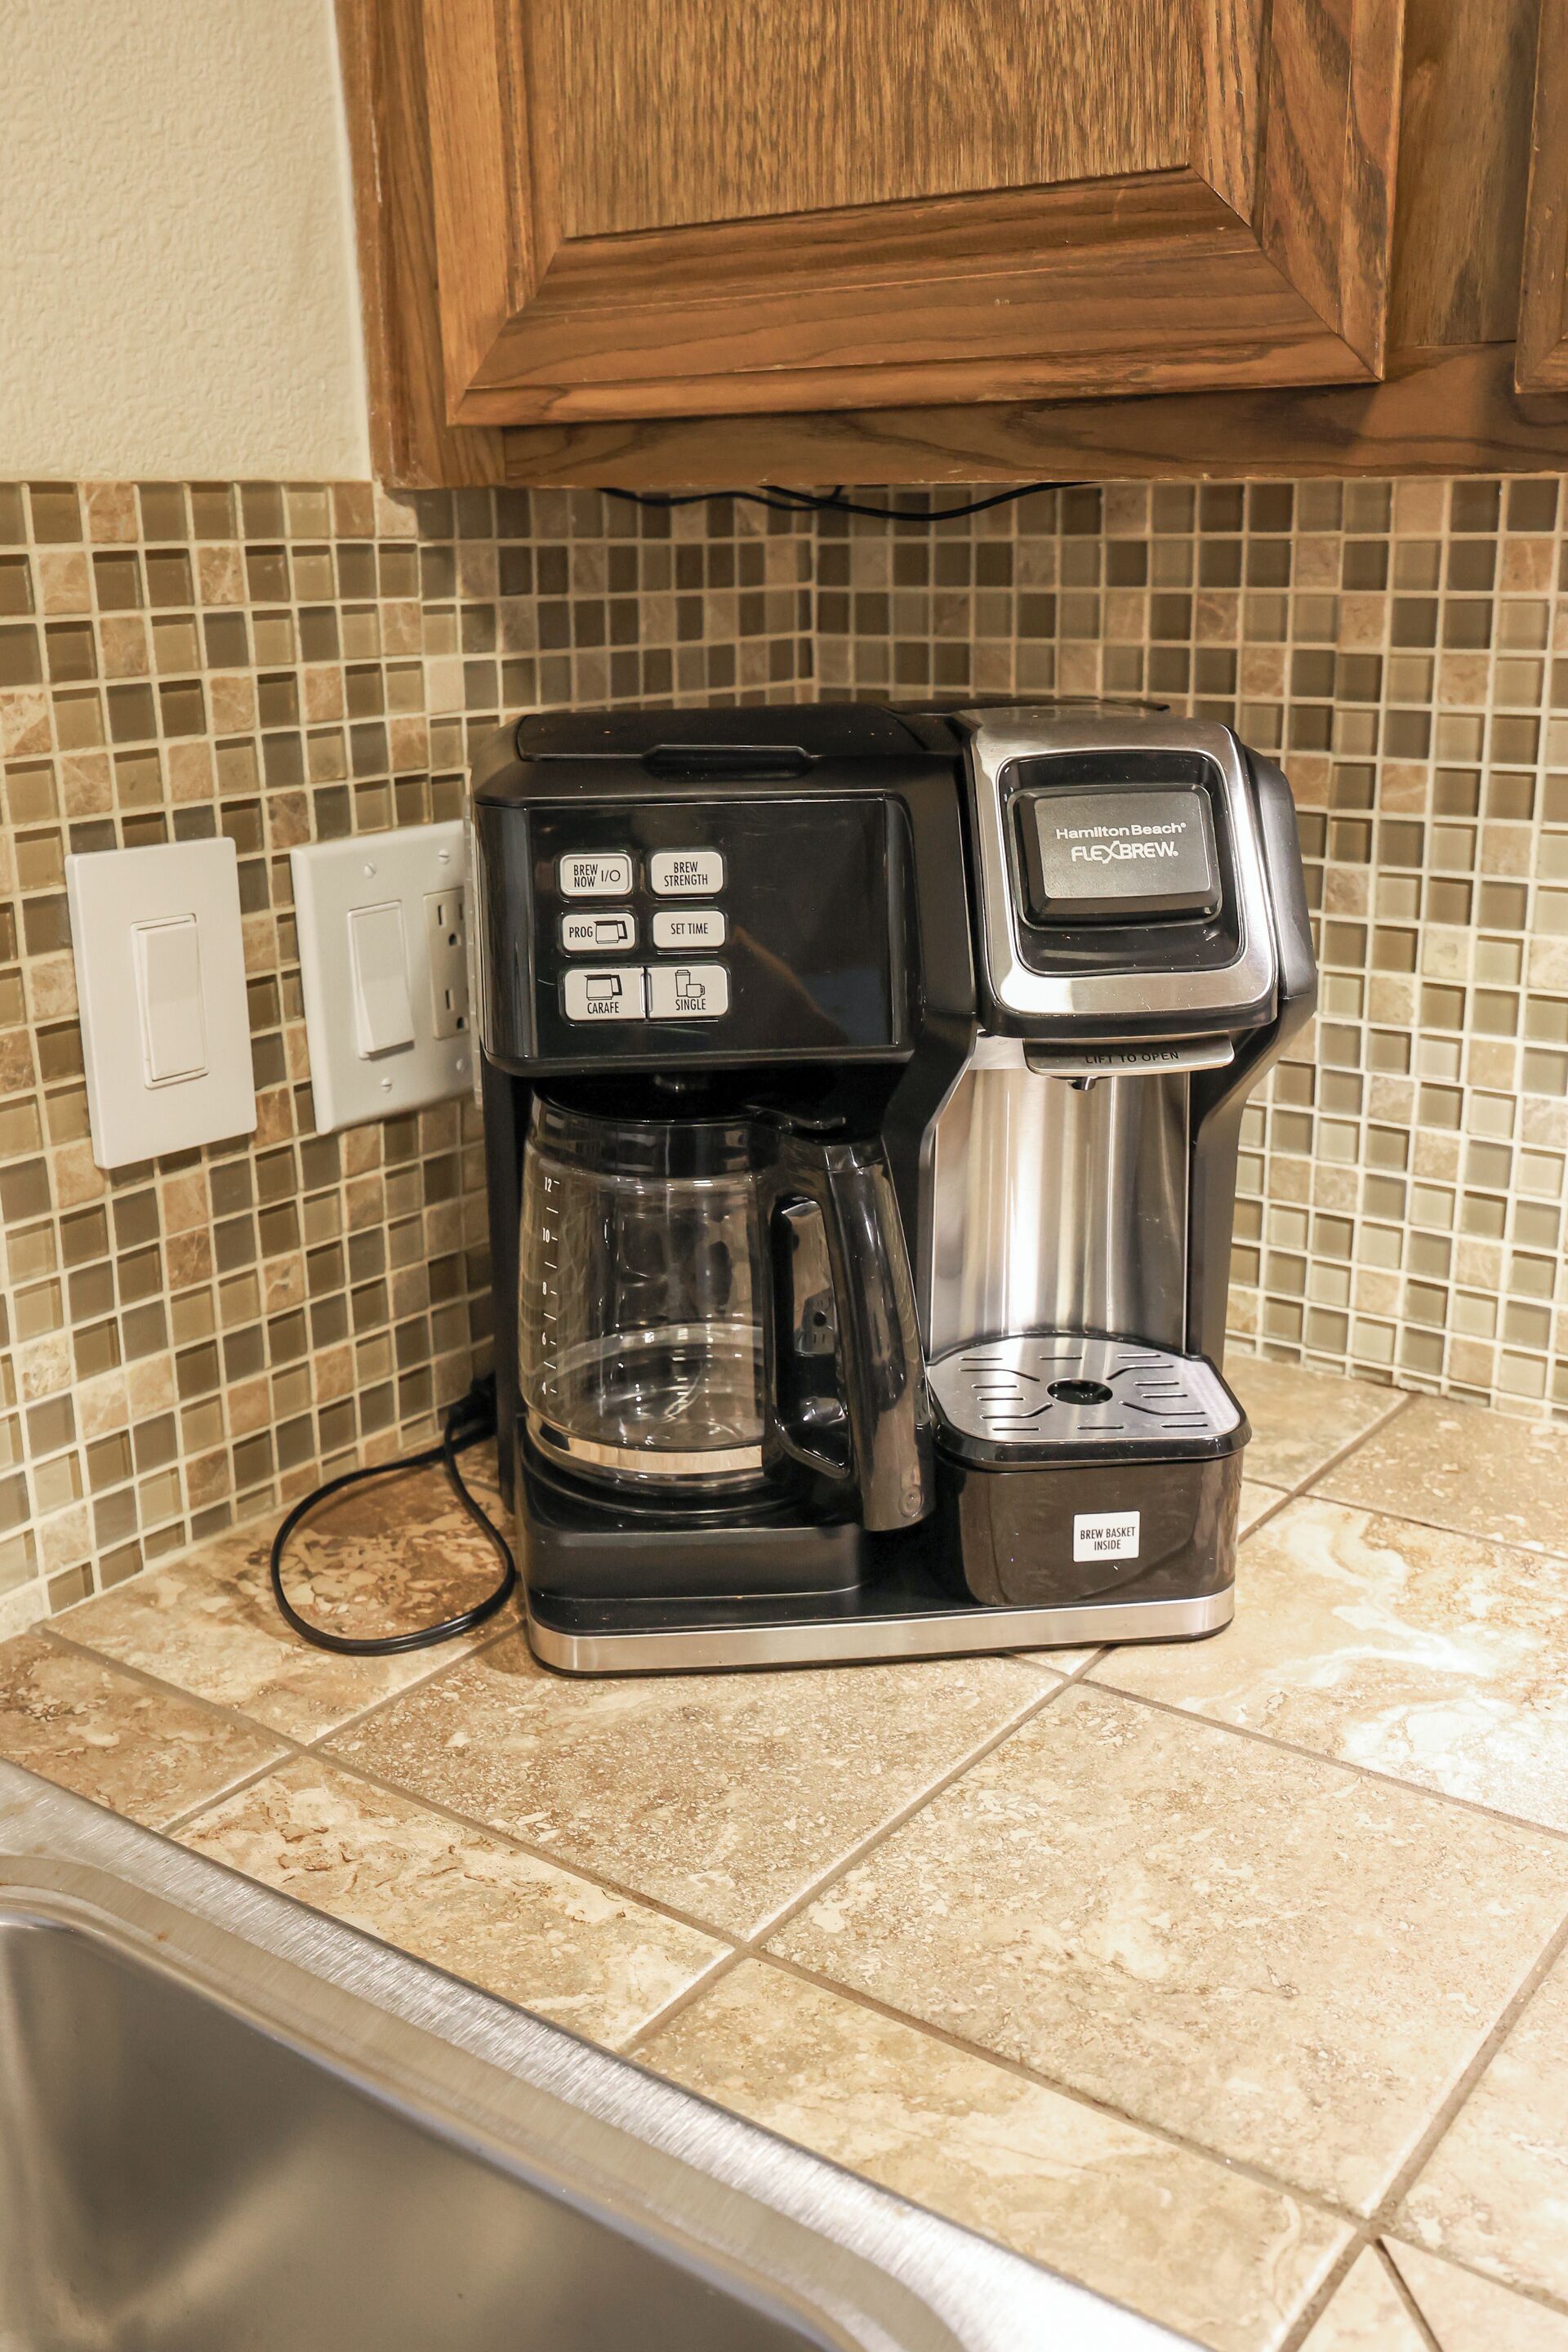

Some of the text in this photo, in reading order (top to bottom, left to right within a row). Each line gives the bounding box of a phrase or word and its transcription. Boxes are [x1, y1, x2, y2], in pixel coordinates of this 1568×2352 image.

[1055, 826, 1129, 840] Hamilton
[573, 864, 598, 875] BREW
[674, 862, 698, 873] BREW
[601, 869, 621, 882] I/O
[664, 874, 708, 886] STRENGTH
[574, 876, 595, 888] NOW
[569, 926, 594, 938] PROG
[670, 923, 709, 934] SET TIME
[587, 1002, 619, 1014] CARAFE
[675, 999, 706, 1011] SINGLE
[1085, 1051, 1179, 1064] LIFT TO OPEN
[545, 1177, 552, 1192] 12
[542, 1227, 550, 1243] 10
[542, 1281, 547, 1295] 8
[541, 1332, 546, 1346] 6
[541, 1381, 546, 1395] 4
[1080, 1526, 1135, 1539] BREW BASKET
[1094, 1539, 1121, 1551] INSIDE
